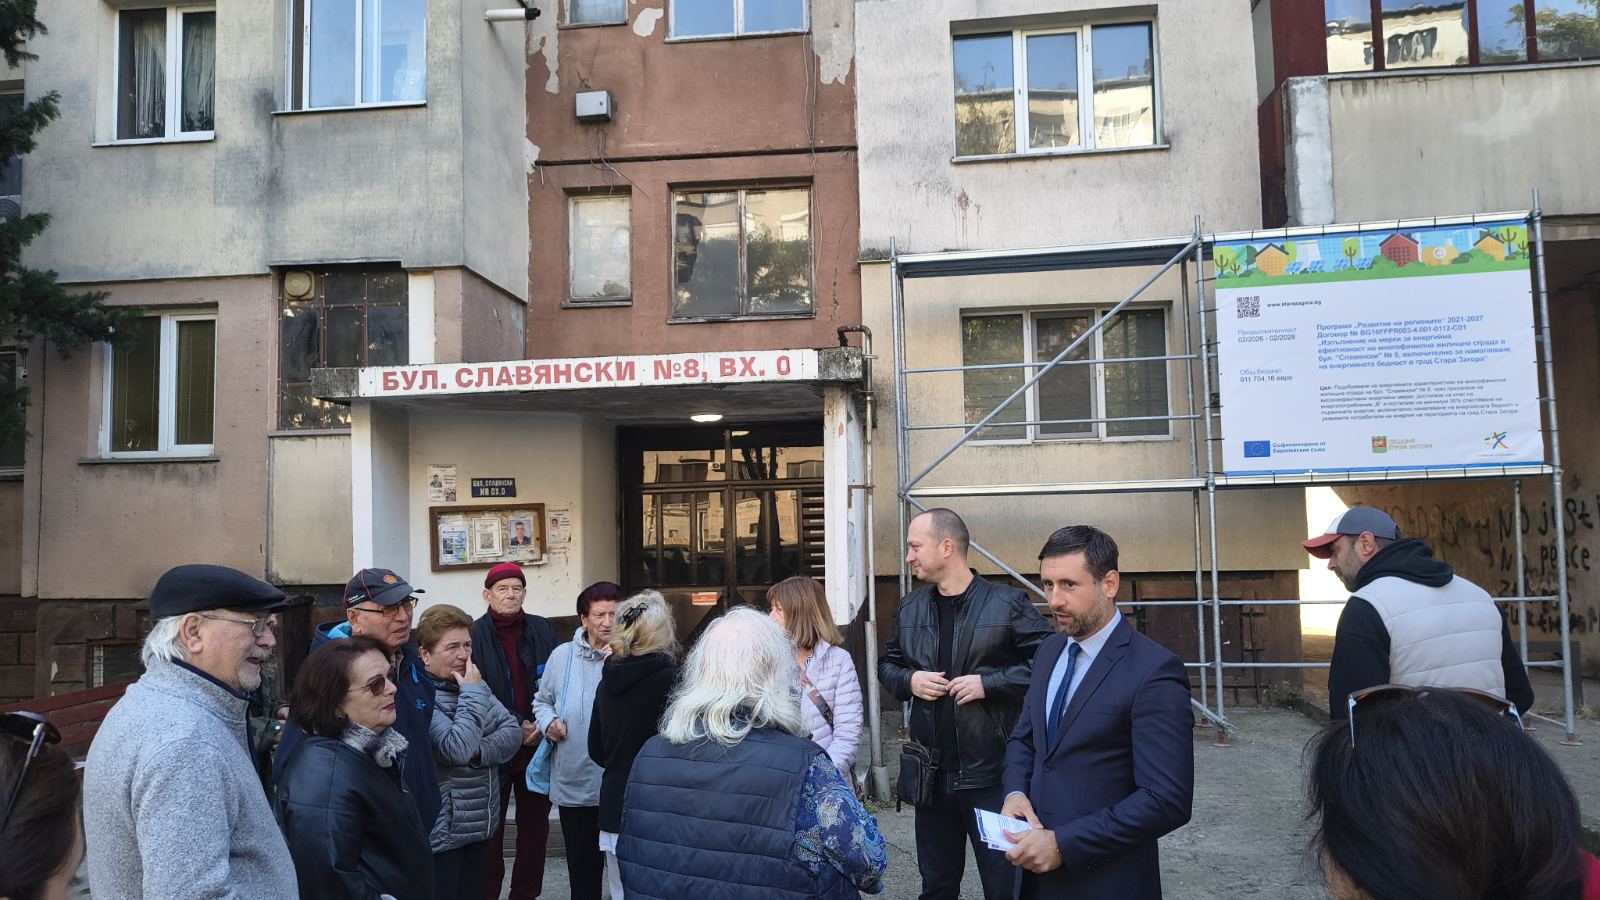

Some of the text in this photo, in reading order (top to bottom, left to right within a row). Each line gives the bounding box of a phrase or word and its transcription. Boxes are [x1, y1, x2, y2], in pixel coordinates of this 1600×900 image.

[383, 370, 446, 390] БУЛ.
[455, 360, 635, 388] СЛАВЯНСКИ
[654, 359, 708, 382] №8,
[720, 357, 765, 377] ВХ.
